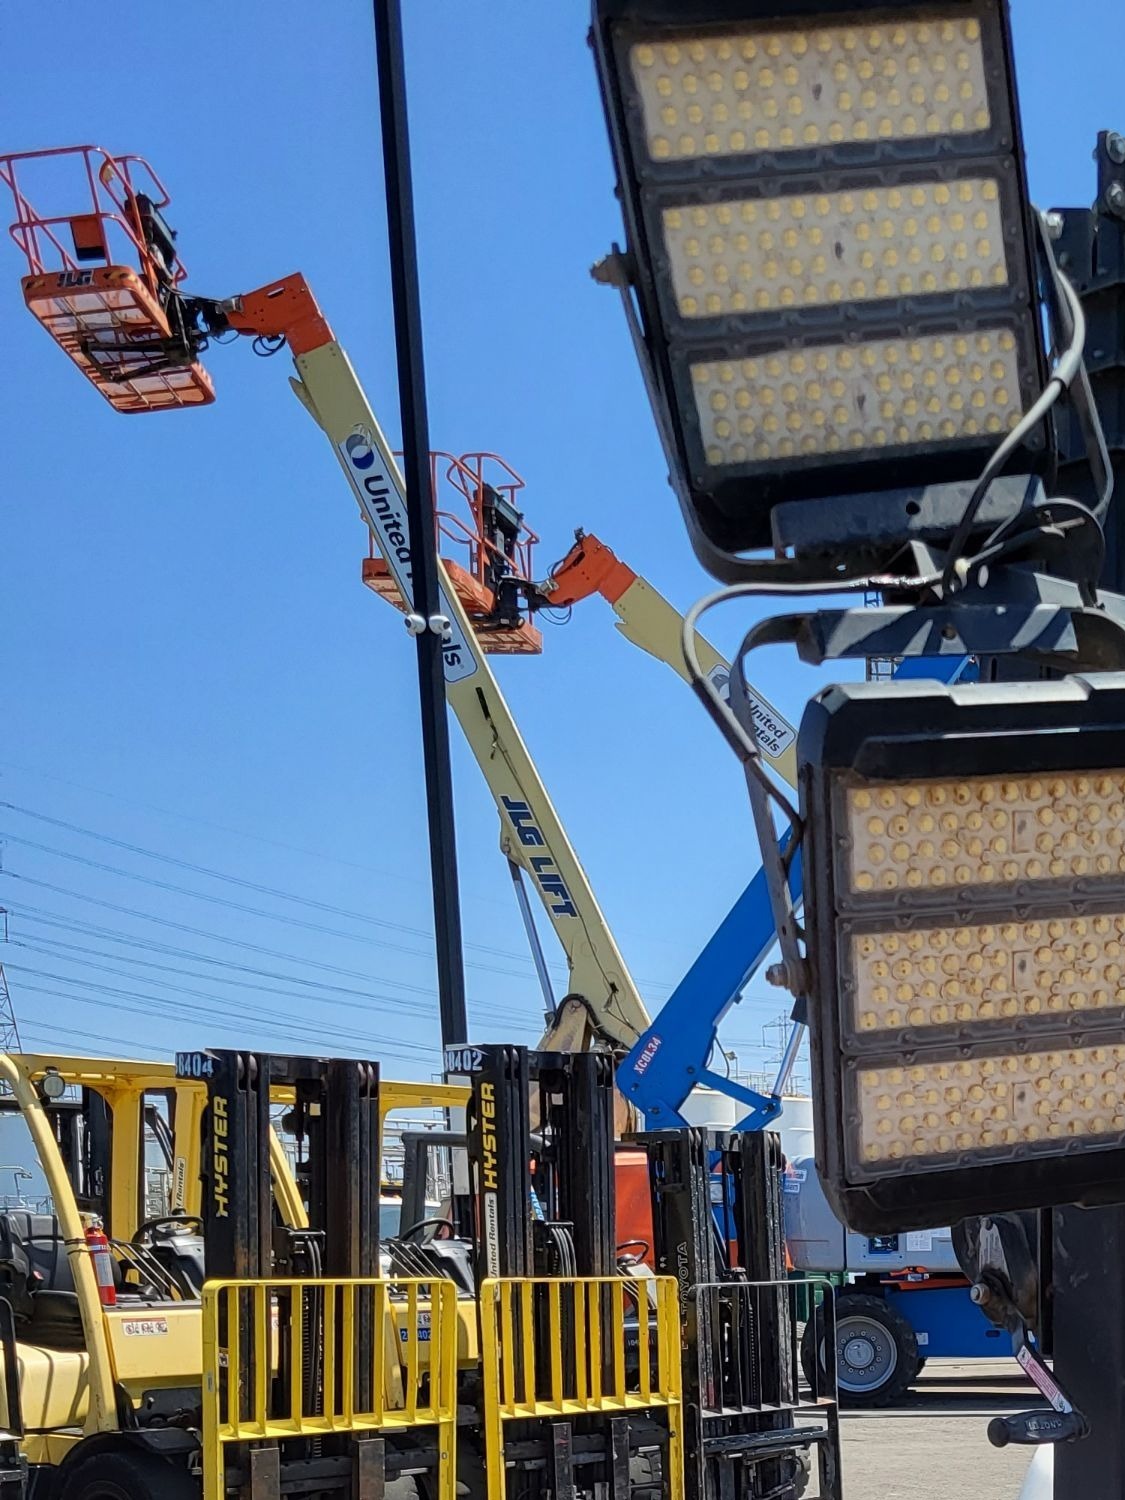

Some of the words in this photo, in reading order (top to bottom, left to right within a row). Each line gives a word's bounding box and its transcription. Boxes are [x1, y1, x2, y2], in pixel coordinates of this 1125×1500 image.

[363, 474, 411, 565] United
[500, 795, 545, 846] JLG
[529, 857, 578, 918] LIFT
[213, 1096, 229, 1218] HYSTER
[480, 1083, 498, 1189] HYSTER
[677, 1241, 690, 1316] TOYOTA
